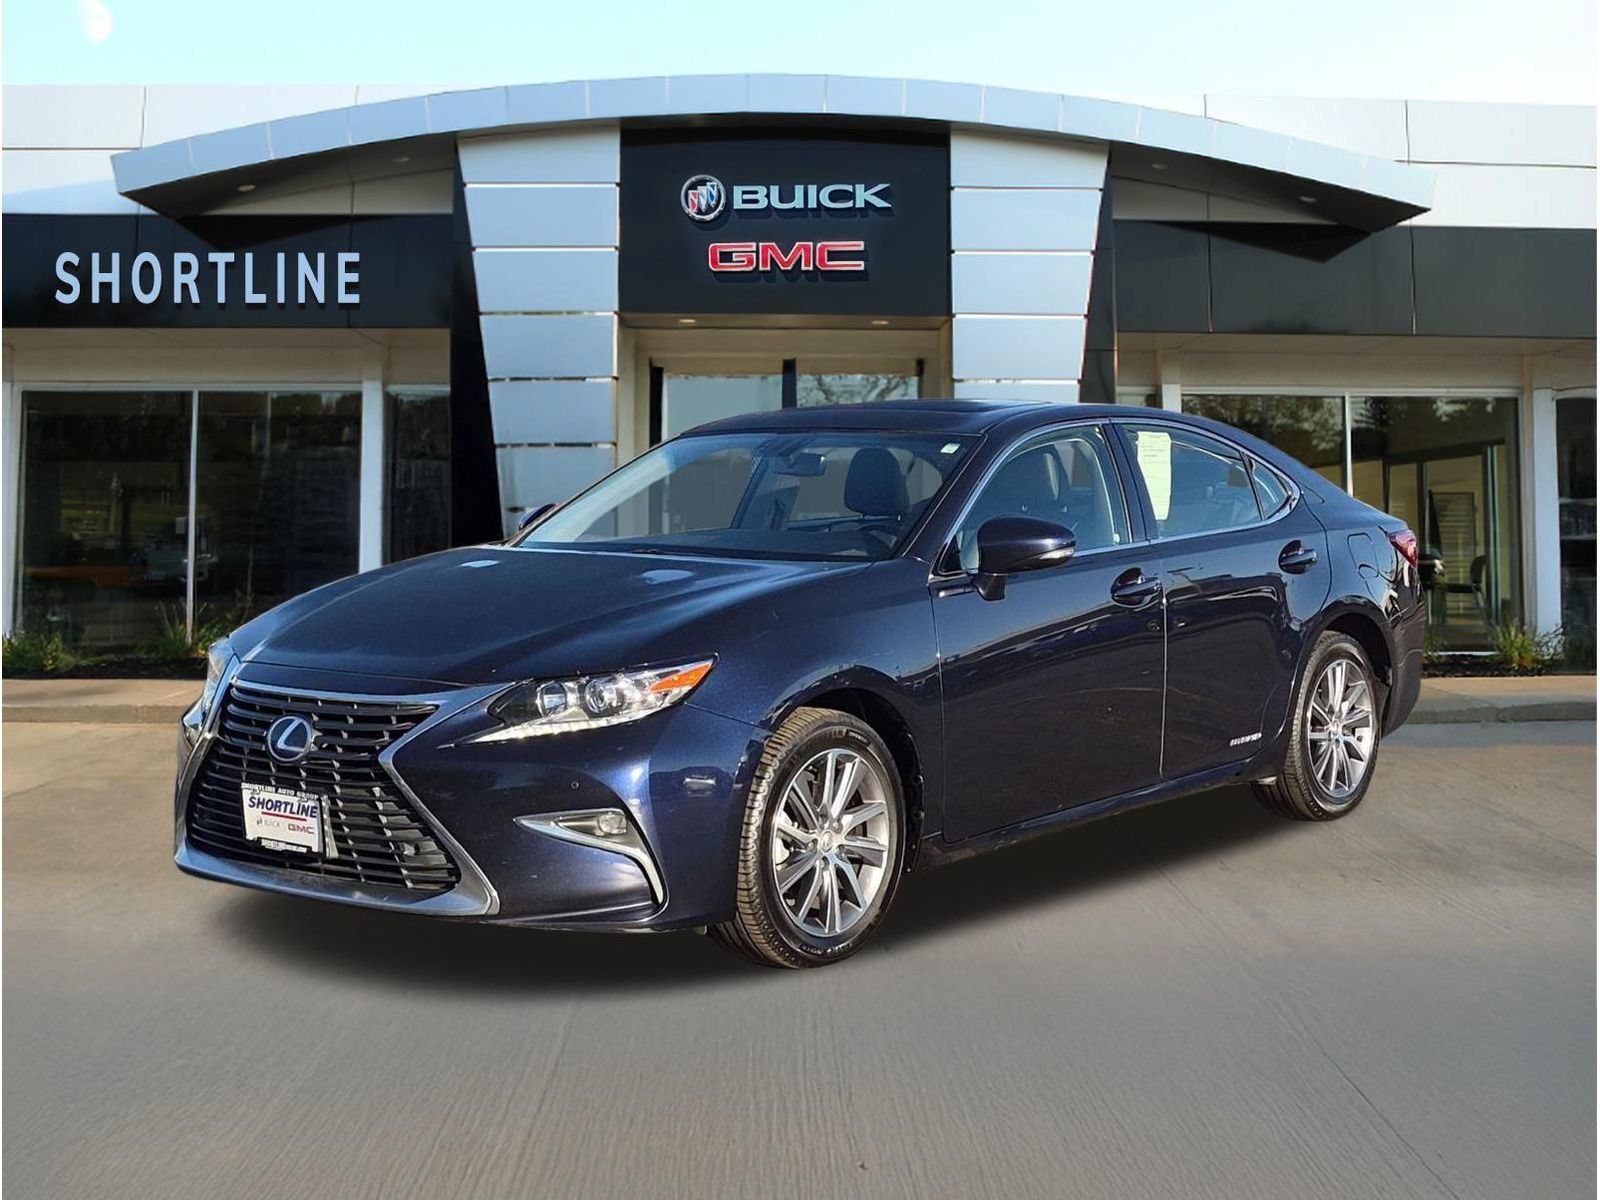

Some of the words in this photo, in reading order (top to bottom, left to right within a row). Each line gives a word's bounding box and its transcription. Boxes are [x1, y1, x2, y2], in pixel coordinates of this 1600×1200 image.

[733, 183, 893, 210] BUICK
[708, 240, 865, 272] GMC
[54, 251, 360, 304] SHORTLINE
[277, 787, 295, 796] AUTO
[248, 796, 318, 818] SHORTLINE
[287, 823, 315, 834] GMC
